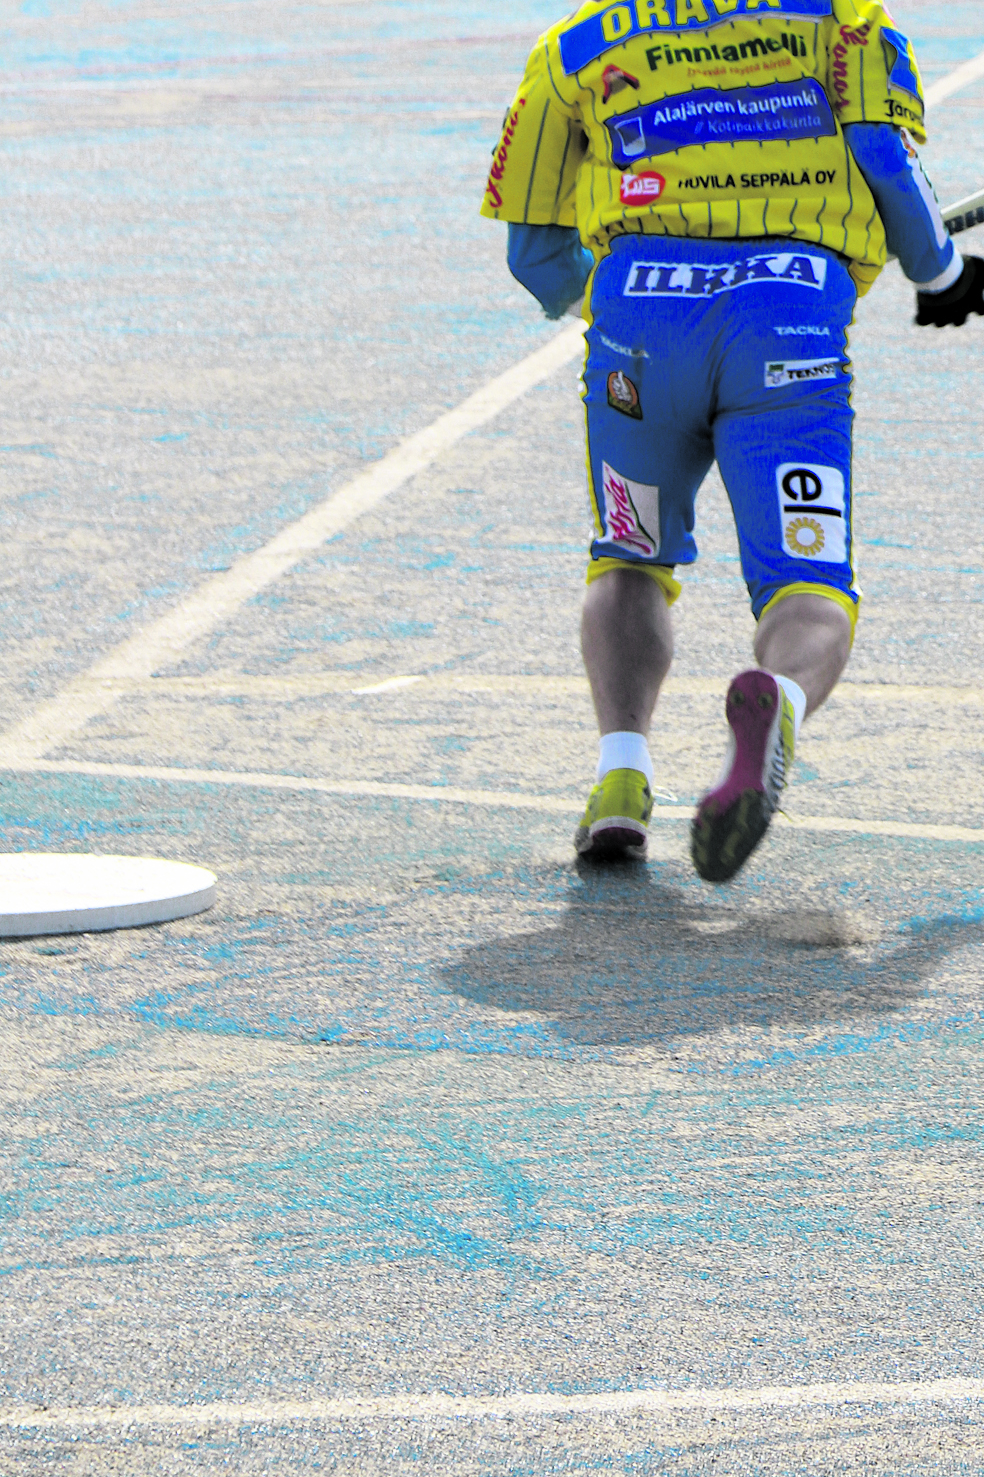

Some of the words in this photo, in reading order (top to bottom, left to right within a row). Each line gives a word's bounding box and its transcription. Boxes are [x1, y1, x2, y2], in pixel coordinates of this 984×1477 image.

[653, 99, 736, 126] Alajärven
[736, 88, 818, 116] kaupunki
[815, 169, 836, 185] OY
[628, 257, 821, 294] ILKKA
[773, 325, 830, 337] TACKLA
